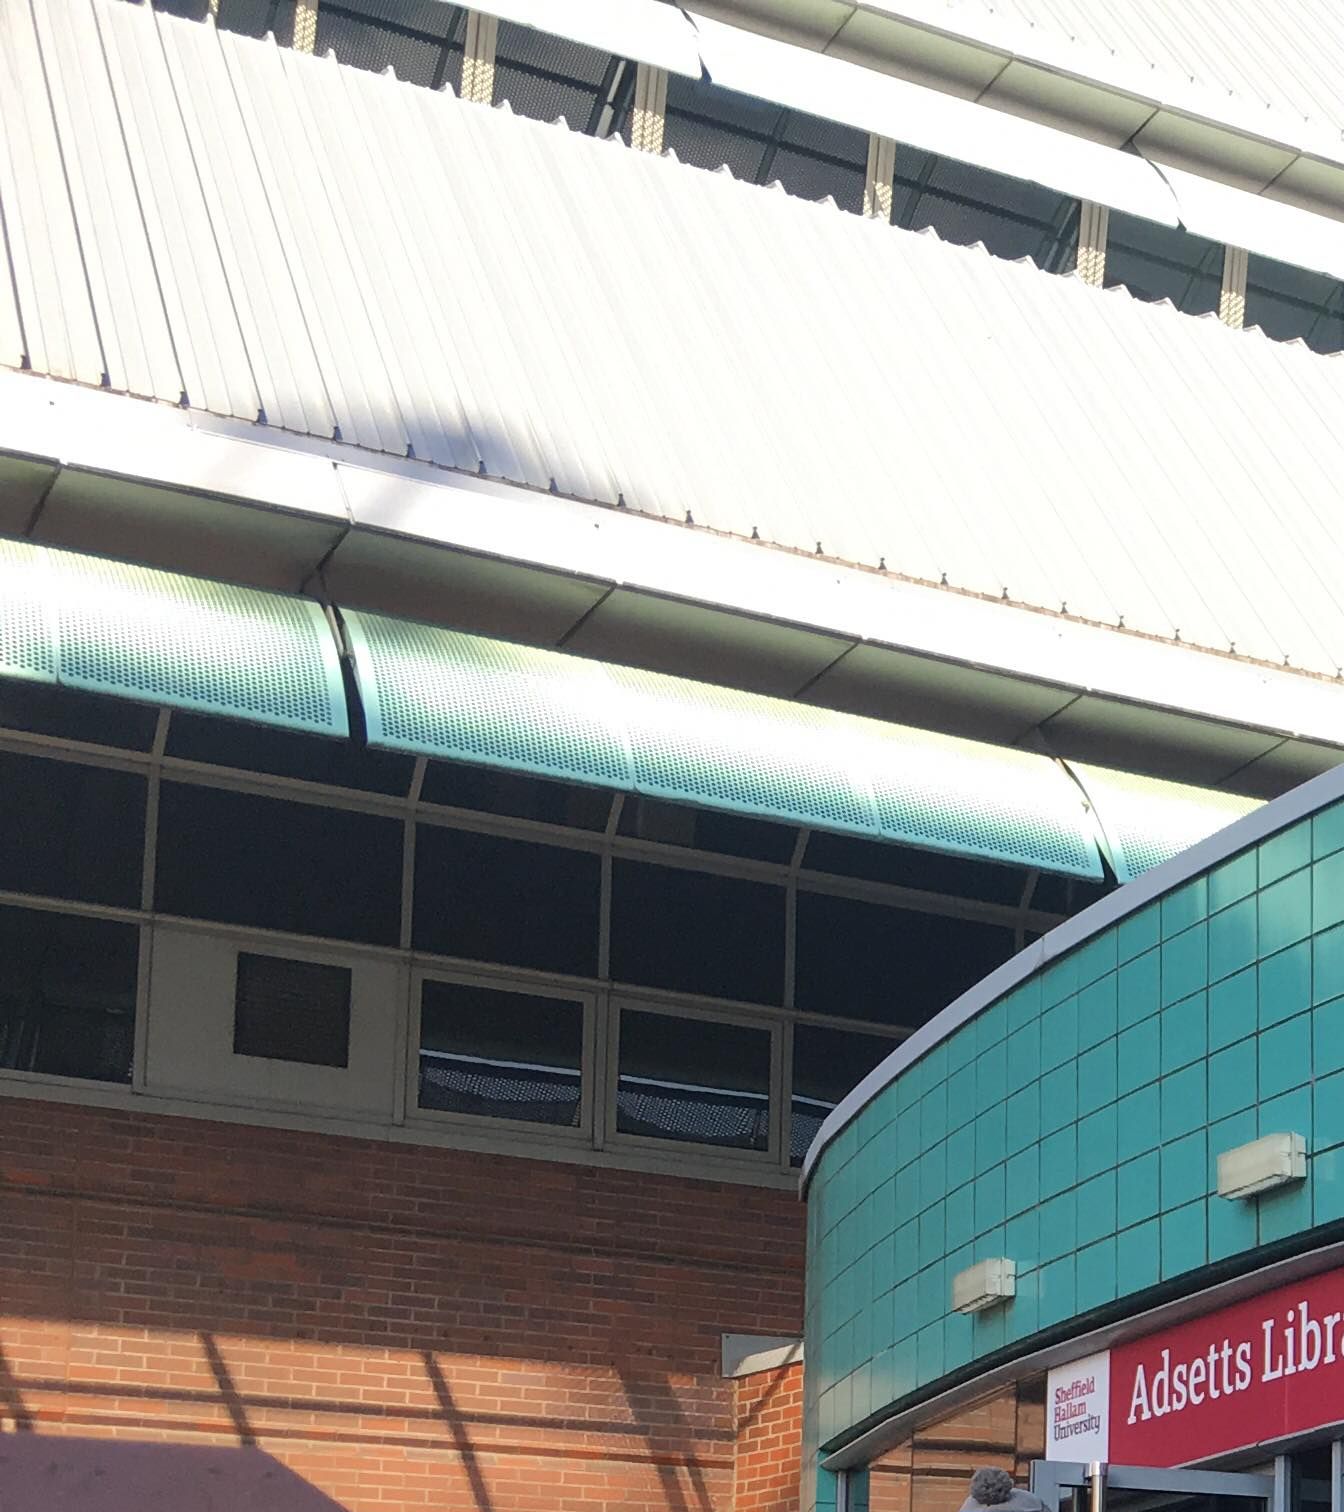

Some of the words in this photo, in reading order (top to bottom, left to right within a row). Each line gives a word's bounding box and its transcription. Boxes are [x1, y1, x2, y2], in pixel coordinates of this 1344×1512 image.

[1054, 1375, 1096, 1405] Sheffield
[1127, 1339, 1252, 1425] Adsetts
[1053, 1401, 1087, 1424] Hallam
[1053, 1414, 1101, 1442] University
